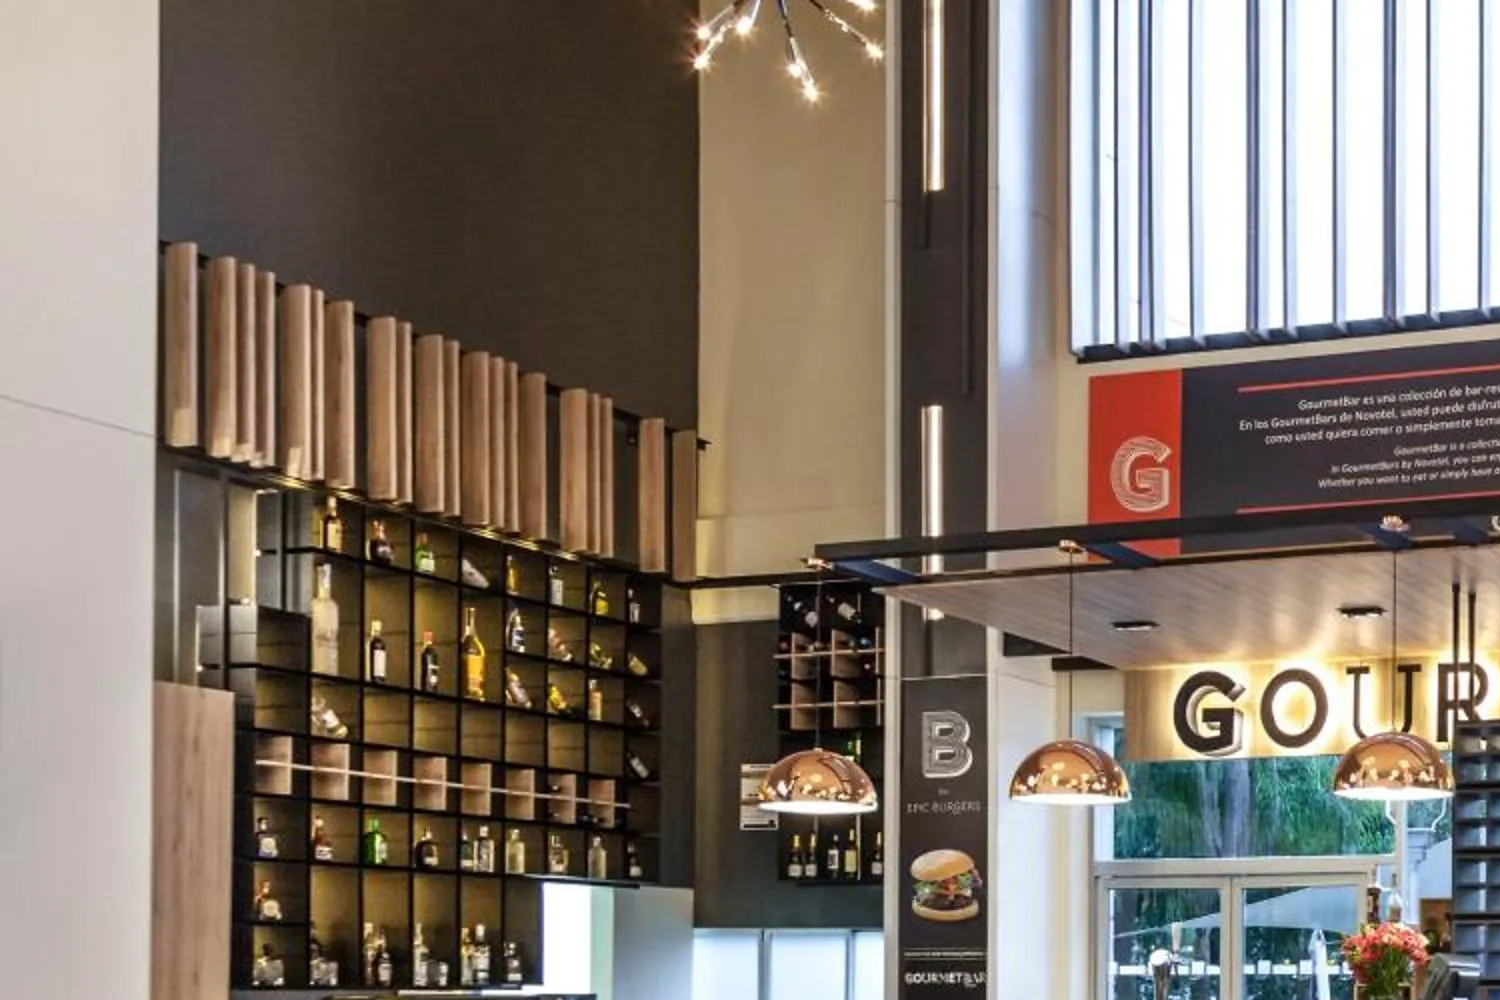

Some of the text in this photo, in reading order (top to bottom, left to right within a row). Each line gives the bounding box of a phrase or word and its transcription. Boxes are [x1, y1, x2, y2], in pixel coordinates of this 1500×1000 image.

[1297, 394, 1360, 411] GourmetBar
[1363, 395, 1375, 405] es
[1377, 393, 1396, 404] una
[1398, 386, 1447, 402] colección
[1449, 385, 1463, 397] de
[1239, 419, 1253, 431] En
[1254, 418, 1270, 429] los
[1271, 413, 1337, 428] GourmetBars
[1339, 411, 1353, 422] de
[1355, 407, 1398, 421] Novotel,
[1400, 404, 1429, 417] usted
[1431, 401, 1465, 417] puede
[1265, 434, 1293, 444] como
[1295, 429, 1323, 442] usted
[1325, 428, 1358, 441] quiera
[1359, 426, 1394, 436] comer
[1395, 425, 1403, 434] o
[1404, 417, 1473, 433] simplemente
[1110, 435, 1172, 513] G
[921, 711, 973, 778] B
